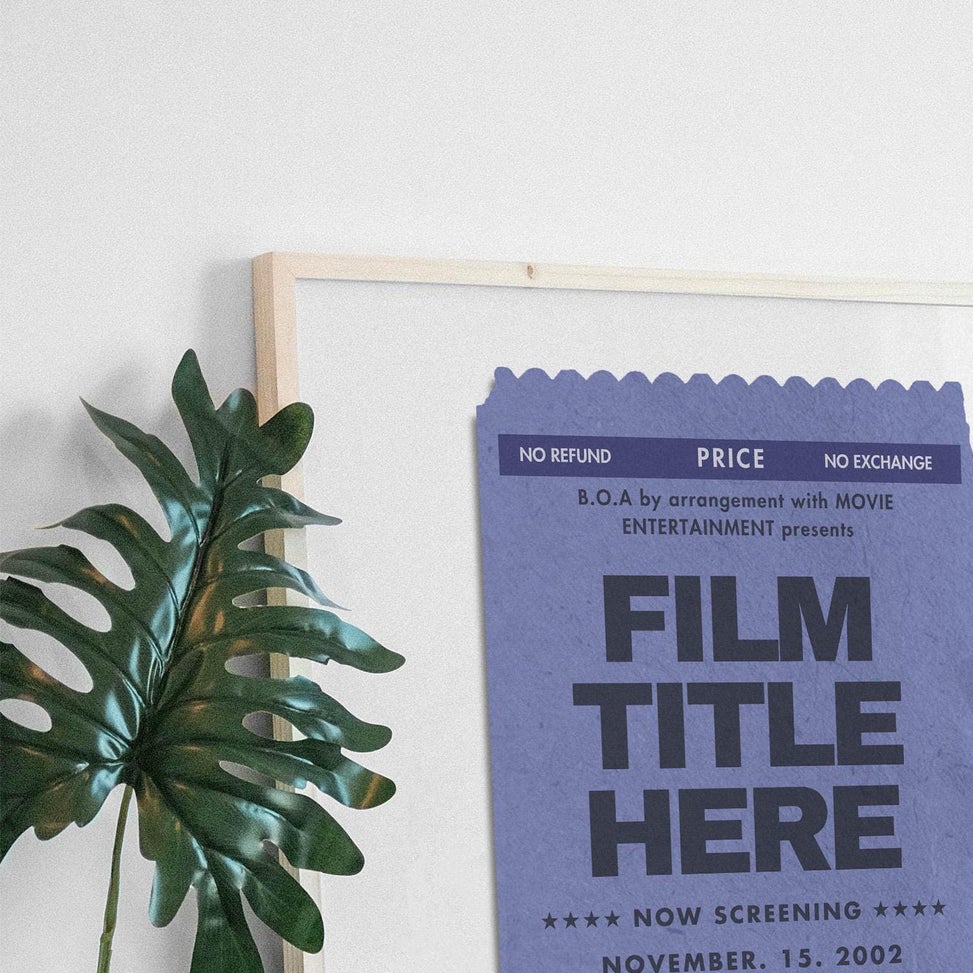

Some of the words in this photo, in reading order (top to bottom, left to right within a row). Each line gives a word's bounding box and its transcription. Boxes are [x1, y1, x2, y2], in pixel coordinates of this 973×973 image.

[519, 446, 546, 463] NO
[550, 447, 612, 464] REFUND
[697, 447, 765, 469] PRICE
[824, 453, 850, 469] NO
[853, 454, 933, 471] EXCHANGE
[577, 488, 633, 507] B.O.A
[639, 487, 662, 512] by
[668, 493, 785, 513] arrangement
[790, 491, 828, 509] with
[835, 492, 894, 511] MOVIE
[622, 517, 775, 537] ENTERTAINMENT
[781, 522, 855, 542] presents
[602, 574, 873, 663] FILM
[572, 680, 905, 770] TITLE
[588, 784, 903, 878] HERE
[633, 906, 702, 928] NOW
[714, 900, 862, 925] SCREENING
[781, 948, 822, 969] 15.
[835, 944, 903, 966] 2002
